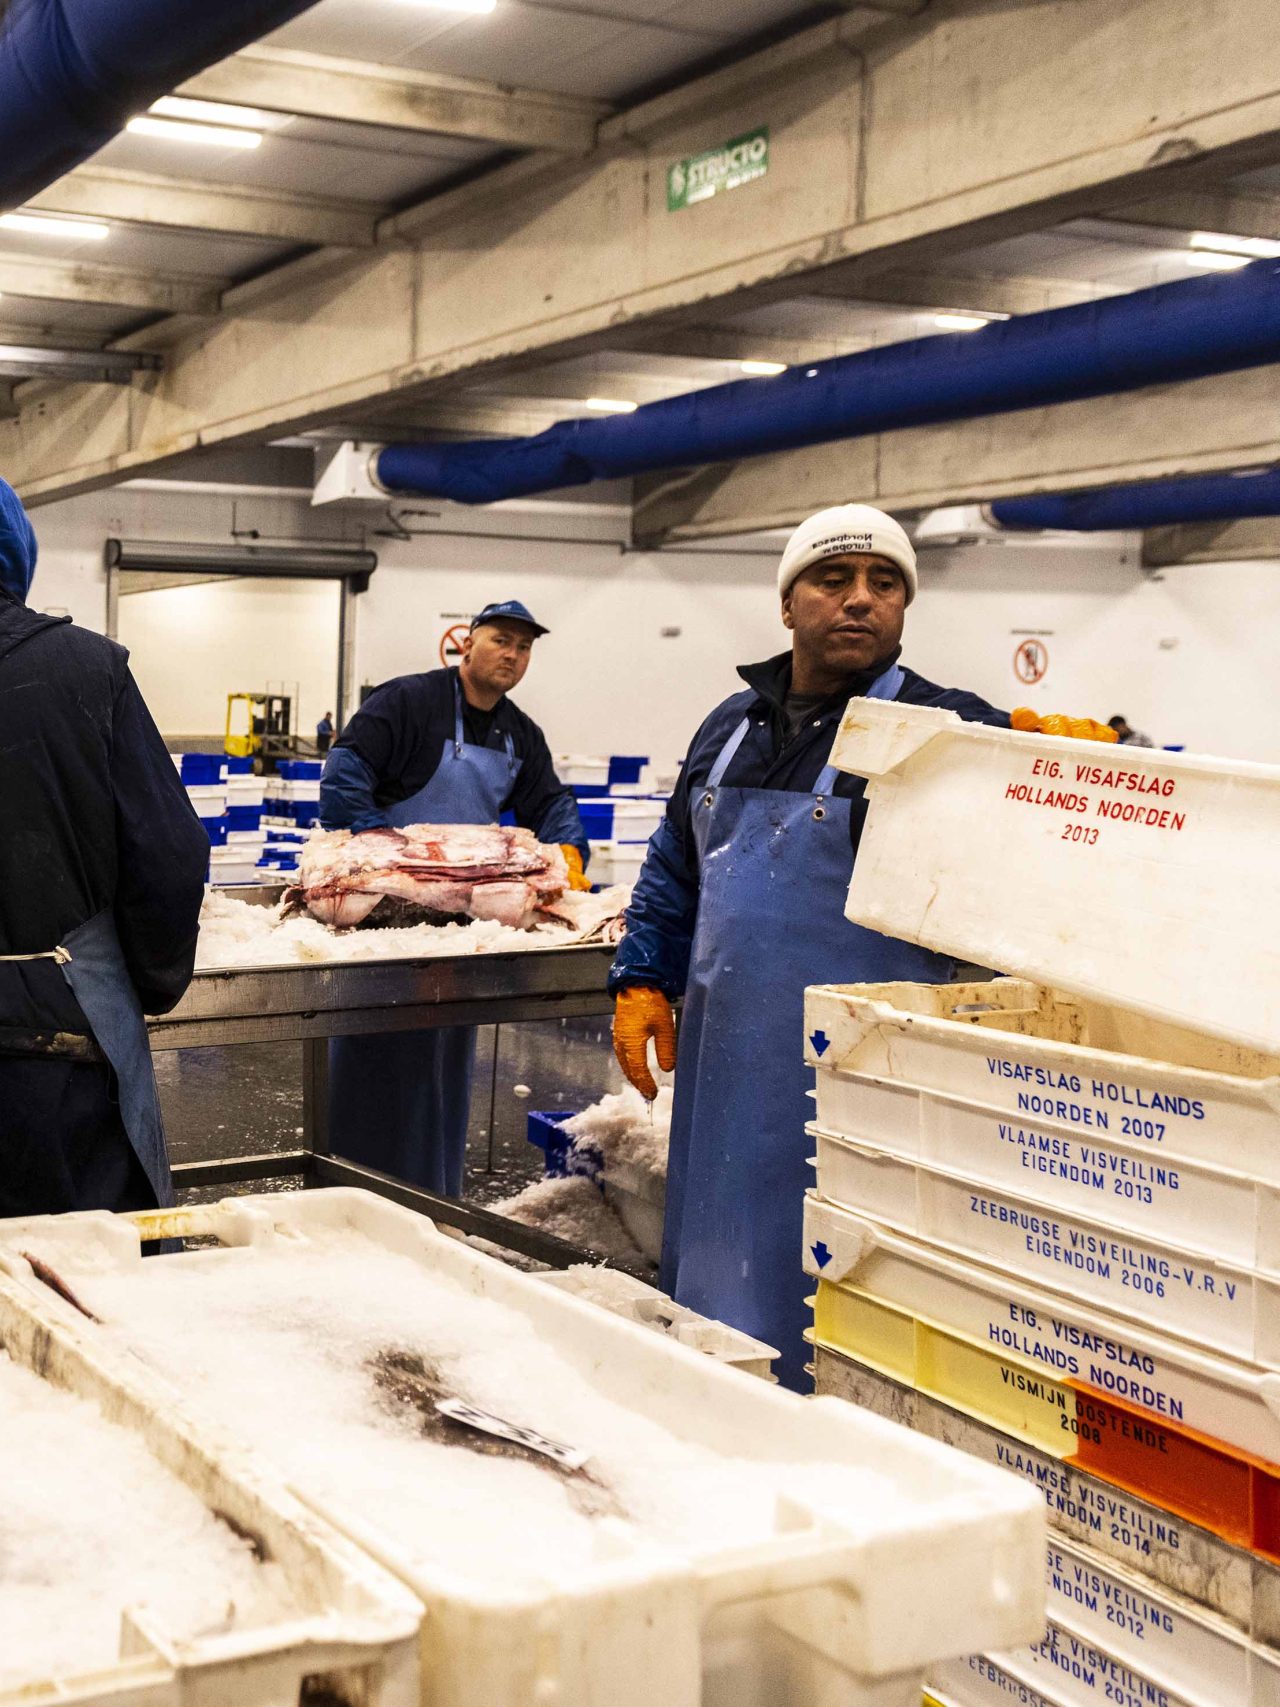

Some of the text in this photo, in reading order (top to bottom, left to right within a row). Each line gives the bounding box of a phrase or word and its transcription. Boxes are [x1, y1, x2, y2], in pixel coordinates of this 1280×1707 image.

[1005, 783, 1186, 831] HOLLANDS NOORDEN
[1032, 759, 1176, 797] EIG. VISAFSLAG
[1061, 824, 1100, 845] 2013
[987, 1058, 1205, 1120] VISAFSLAG HOLLANDS
[1018, 1093, 1166, 1142] NOORDEN 2007
[999, 1124, 1179, 1190] VLAAMSE VISVEILING
[1022, 1151, 1153, 1204] EIGENDOM 2013
[970, 1197, 1060, 1241] ZEEBRUGSE
[1026, 1236, 1166, 1298] EIGENDOM 2006
[1010, 1303, 1155, 1375] EIG. VISAFSLAG
[989, 1323, 1184, 1420] HOLLANDS NOORDEN
[1000, 1367, 1169, 1454] VISMIJN OOSTENDE
[1060, 1414, 1101, 1445] 2008
[996, 1443, 1180, 1549] VLAAMSE VISVEILING
[1038, 1485, 1151, 1555] ENDOM 2014
[1074, 1566, 1173, 1633] VISVEILING
[1107, 1605, 1145, 1640] 2012
[1071, 1638, 1168, 1707] VISVEILING
